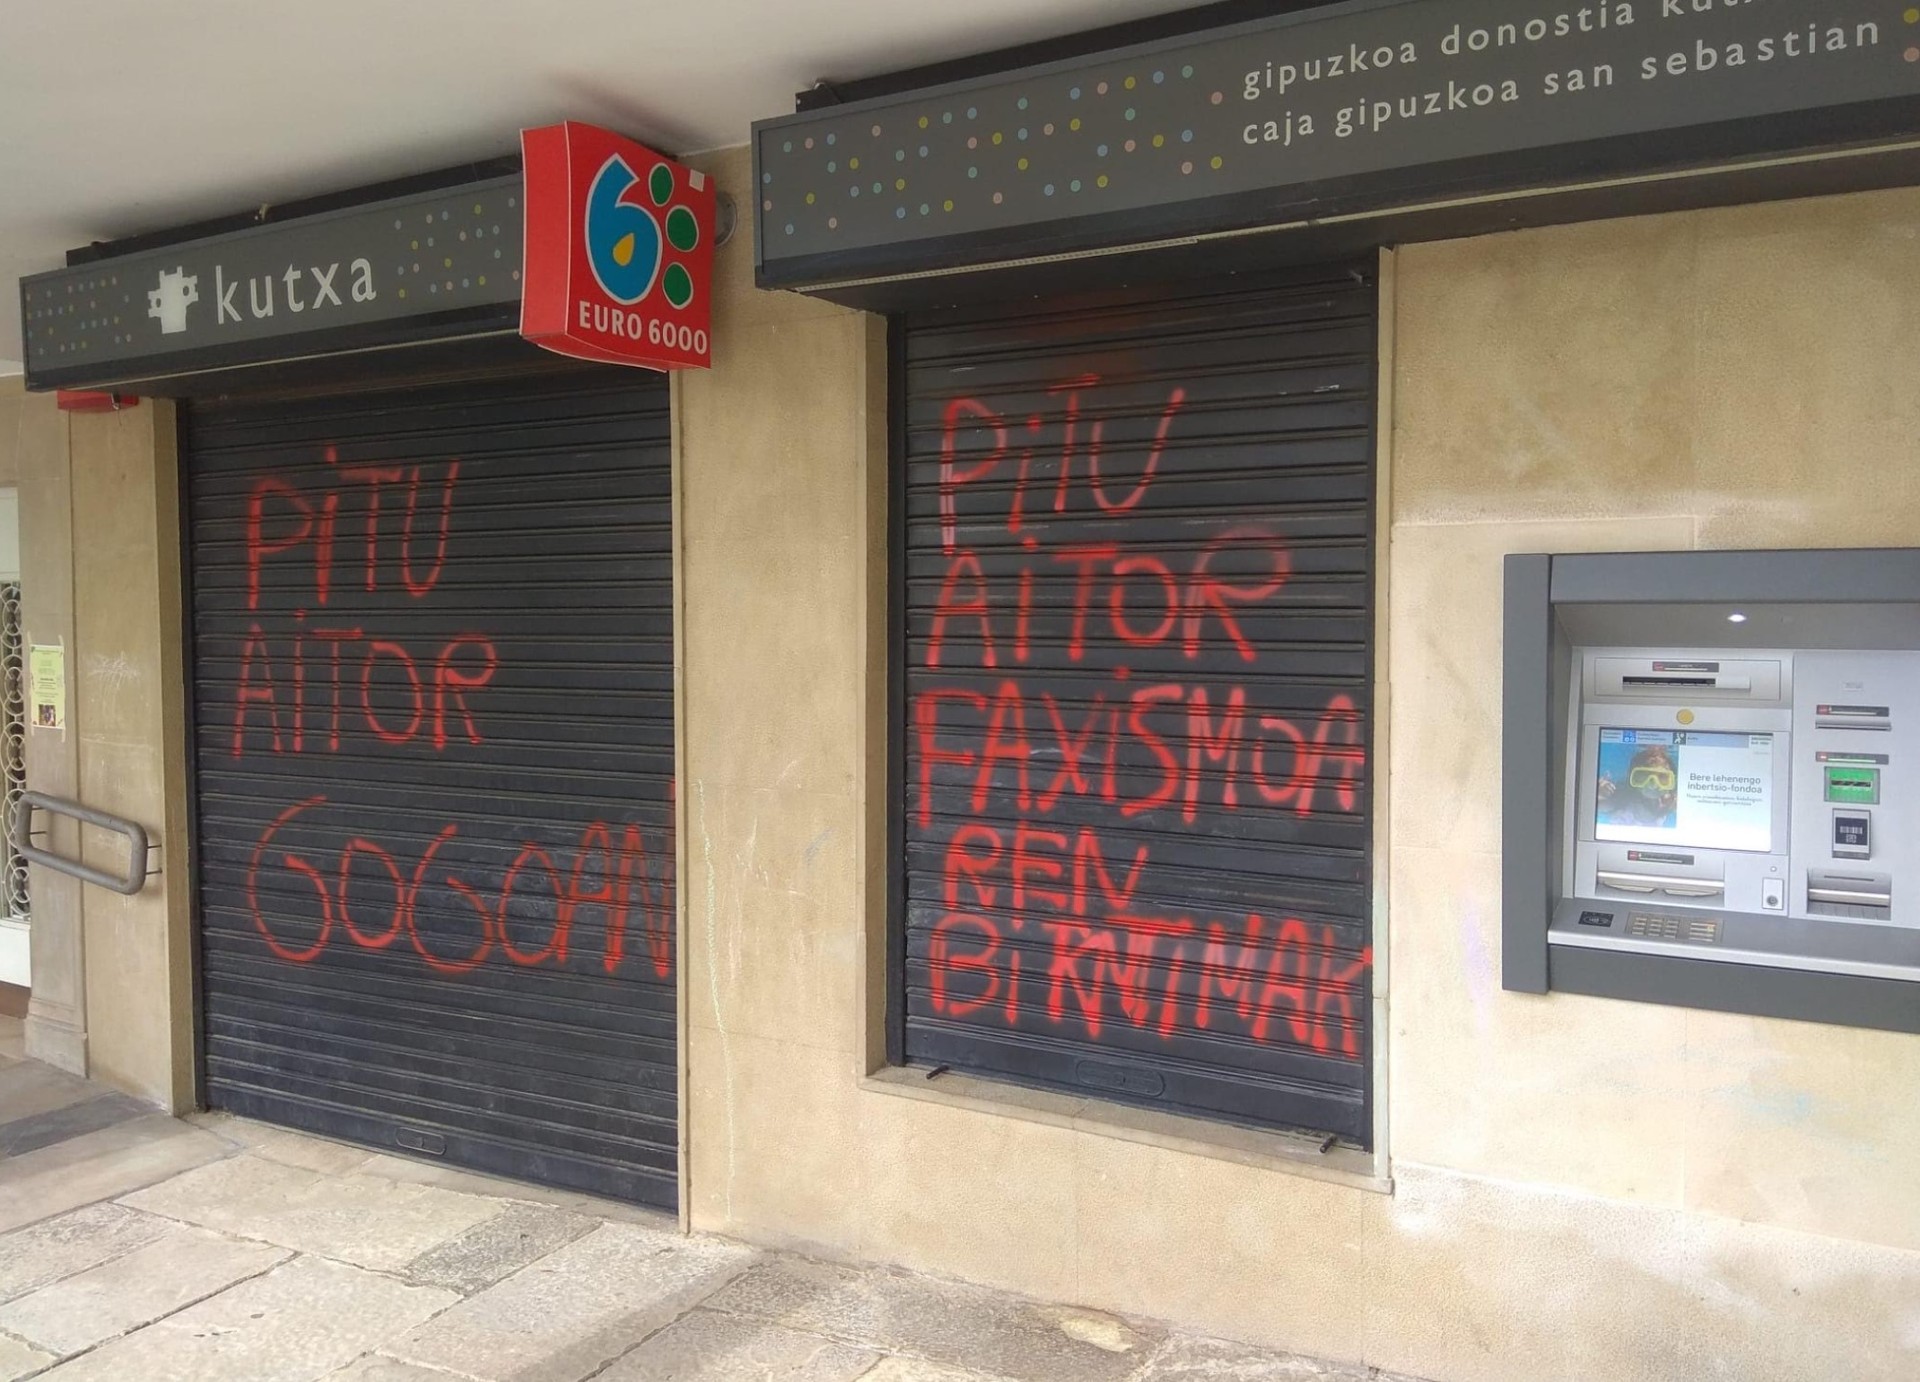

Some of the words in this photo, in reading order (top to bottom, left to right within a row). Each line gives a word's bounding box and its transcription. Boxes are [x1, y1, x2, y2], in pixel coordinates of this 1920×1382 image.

[1243, 42, 1417, 100] gipuzkoa
[1440, 0, 1635, 56] donostia
[1243, 110, 1314, 147] caja
[1335, 77, 1519, 138] gipuzkoa
[1543, 62, 1613, 96] san
[1640, 20, 1879, 80] sebastian
[215, 256, 376, 326] kutxa
[579, 300, 642, 340] EURO
[648, 318, 707, 355] 6000
